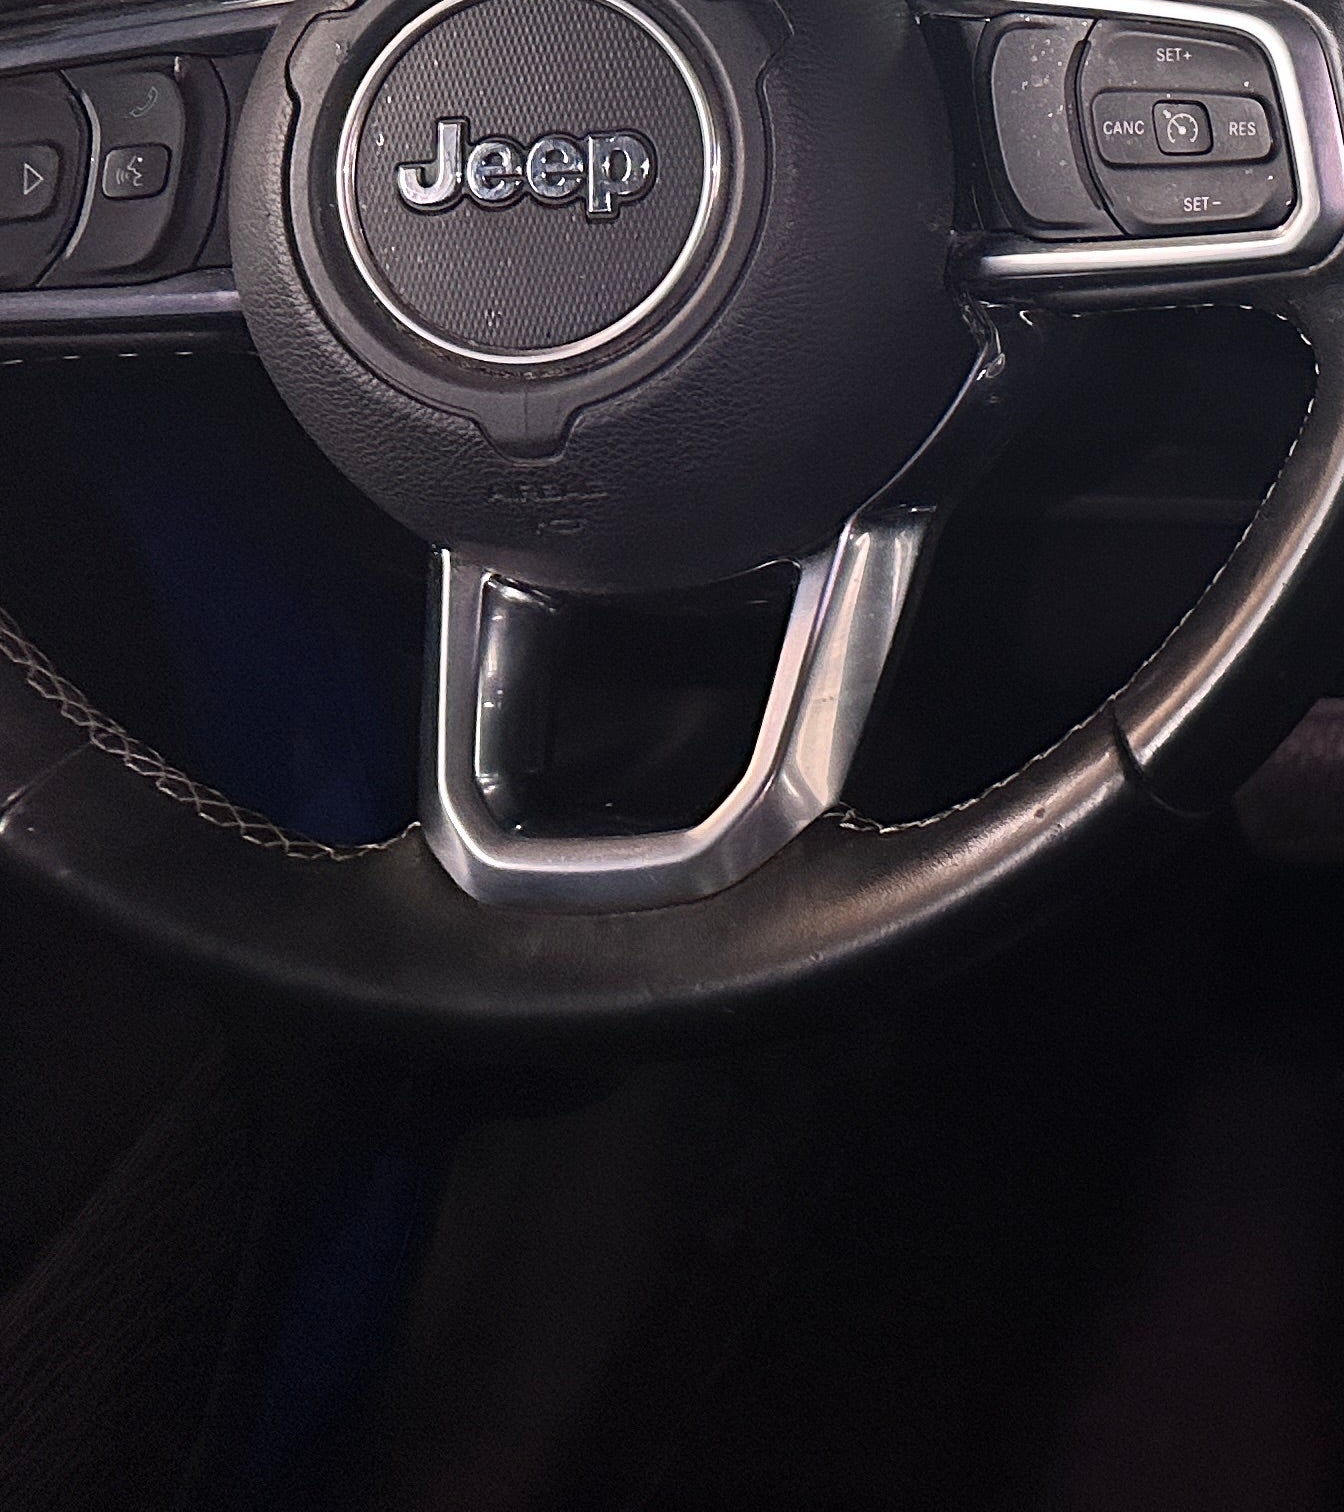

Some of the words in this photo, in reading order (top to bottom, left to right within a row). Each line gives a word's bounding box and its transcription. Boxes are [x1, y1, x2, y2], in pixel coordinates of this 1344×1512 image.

[1156, 48, 1192, 63] SET+
[1103, 121, 1145, 136] CANC
[1229, 121, 1256, 136] RES
[398, 118, 654, 215] Jeep
